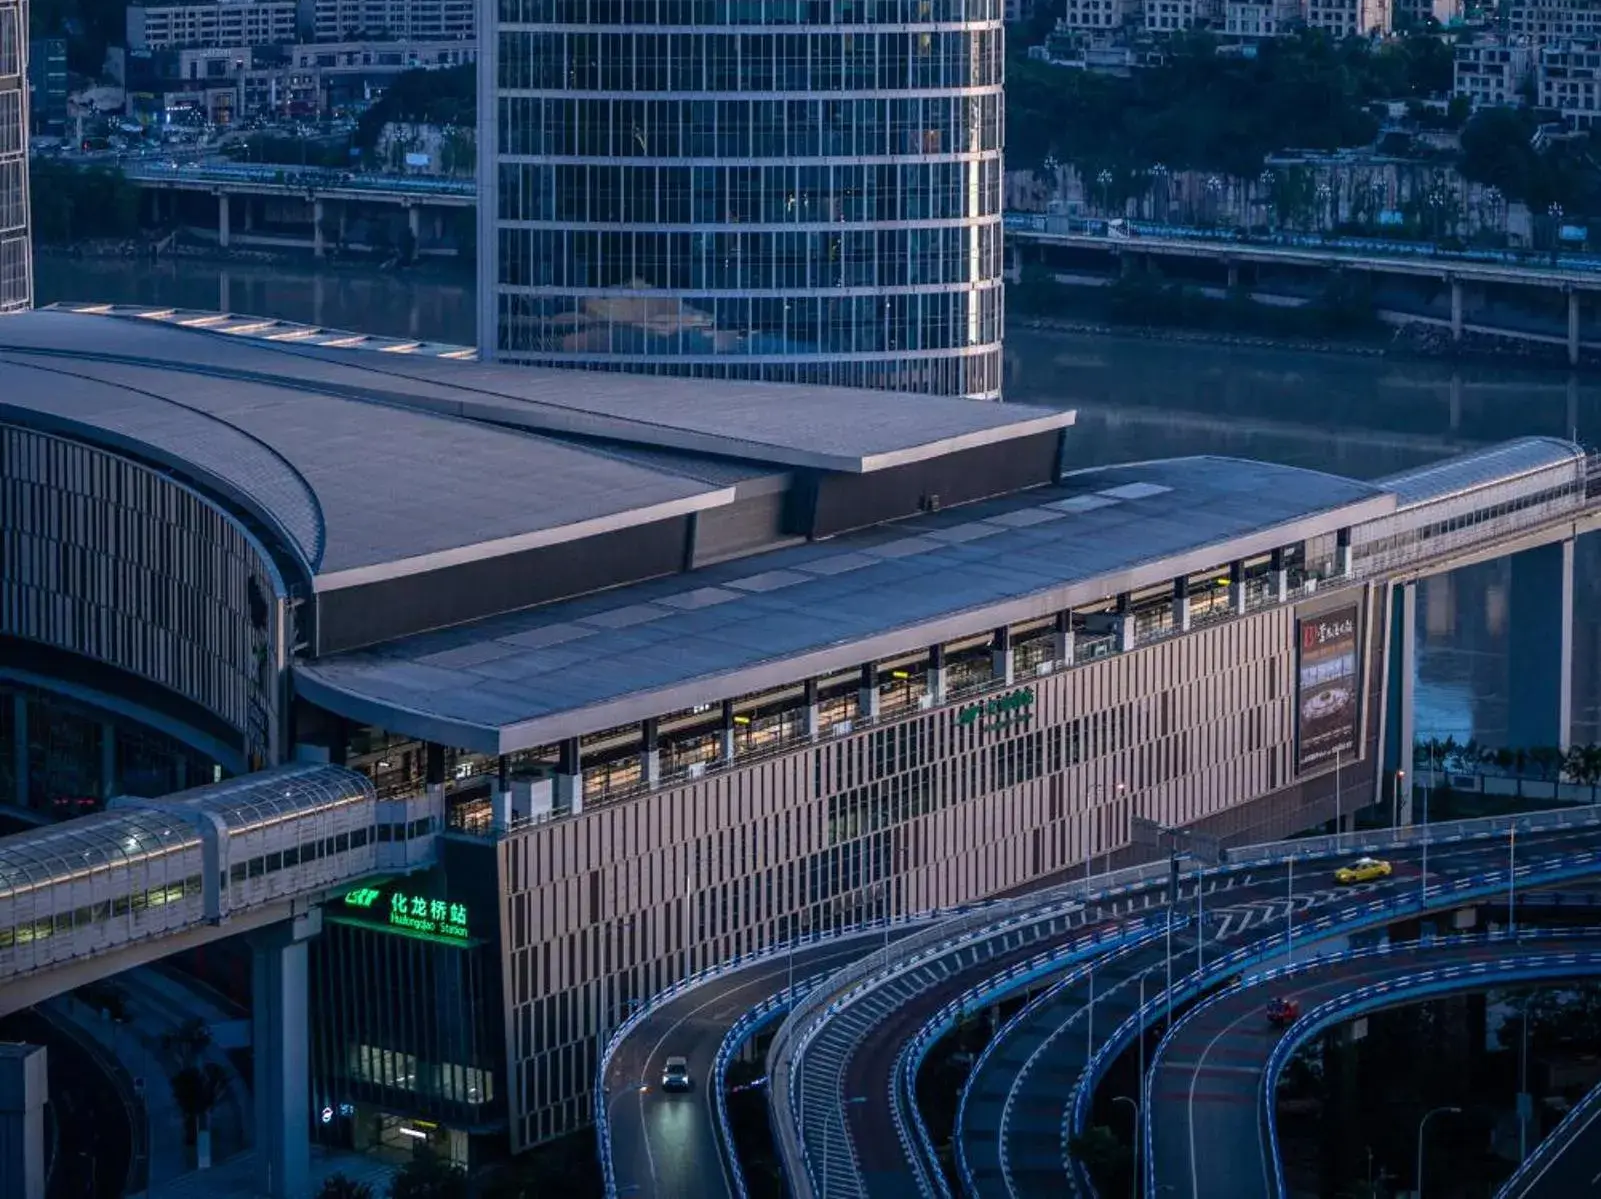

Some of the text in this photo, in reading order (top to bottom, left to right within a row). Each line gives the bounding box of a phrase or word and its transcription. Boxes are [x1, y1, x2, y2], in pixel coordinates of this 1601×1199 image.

[391, 893, 467, 924] 化龙桥站
[440, 922, 468, 937] Station
